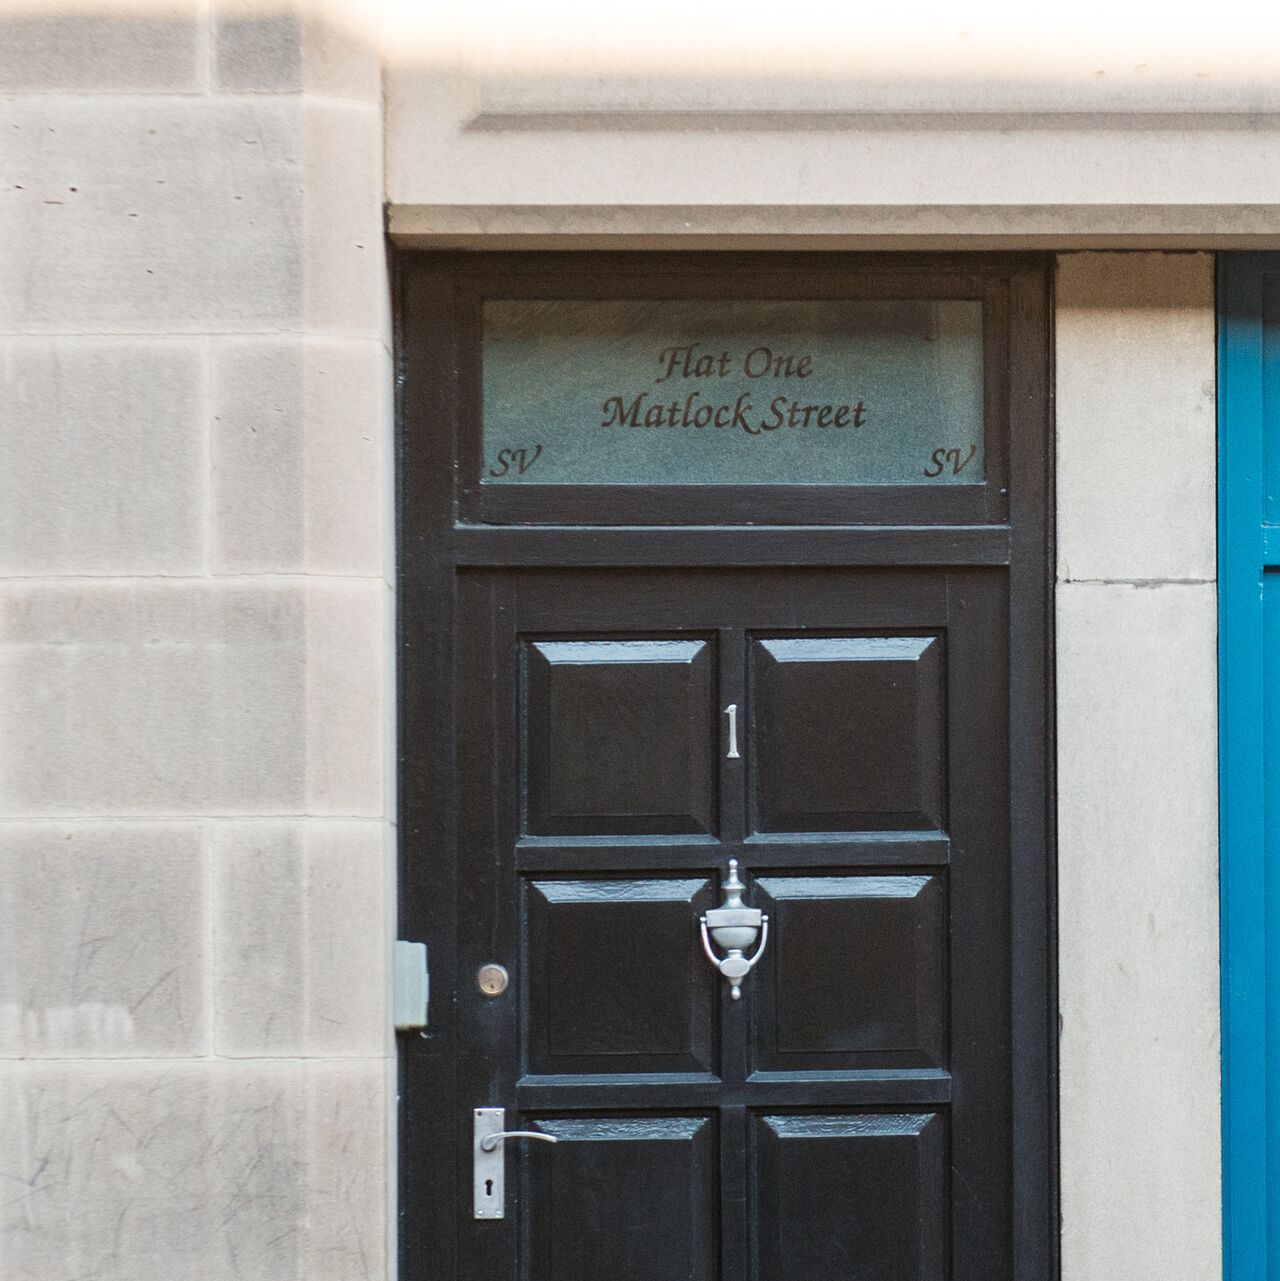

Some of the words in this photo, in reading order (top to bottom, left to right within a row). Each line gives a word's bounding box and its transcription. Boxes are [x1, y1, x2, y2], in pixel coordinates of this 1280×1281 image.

[656, 345, 733, 384] Flat
[743, 346, 814, 381] One
[600, 392, 761, 435] Matlock
[760, 396, 868, 430] Street
[488, 444, 543, 478] SV
[922, 444, 977, 479] SV
[723, 704, 741, 759] 1
